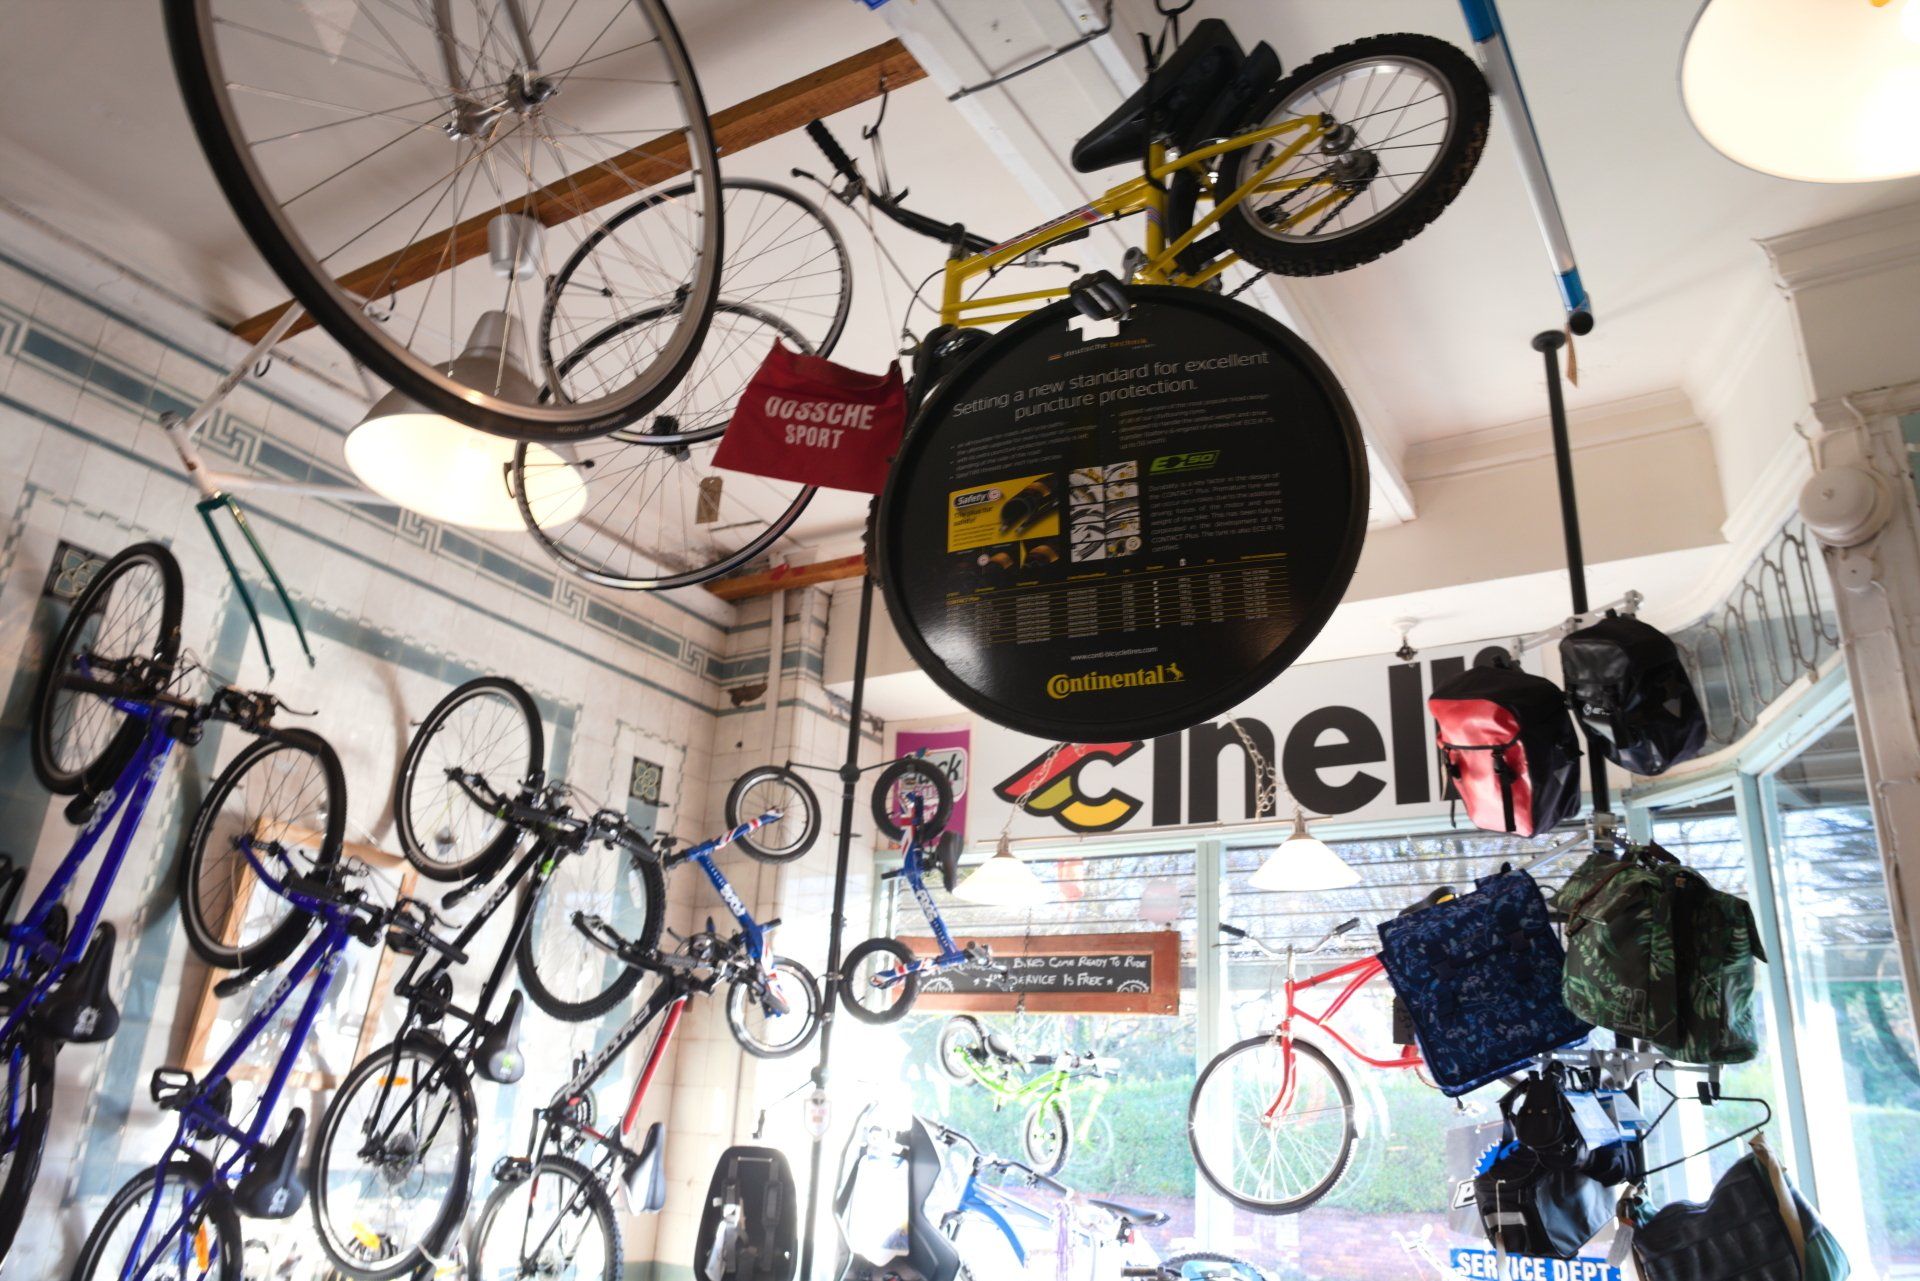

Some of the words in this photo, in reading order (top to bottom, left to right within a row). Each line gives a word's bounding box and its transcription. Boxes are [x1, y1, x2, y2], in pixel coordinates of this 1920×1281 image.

[952, 393, 1010, 418] Setting
[1013, 390, 1025, 402] a
[1028, 379, 1066, 399] new
[1069, 363, 1150, 391] standard
[1154, 361, 1180, 377] for
[1184, 351, 1271, 371] excellent
[1015, 392, 1096, 422] puncture
[1100, 378, 1199, 407] protection.
[785, 424, 844, 449] SPORT
[957, 493, 987, 506] Safety
[1047, 664, 1167, 700] Continental
[1078, 956, 1108, 968] READY
[1124, 956, 1147, 969] RIDE
[1077, 972, 1104, 986] FREE
